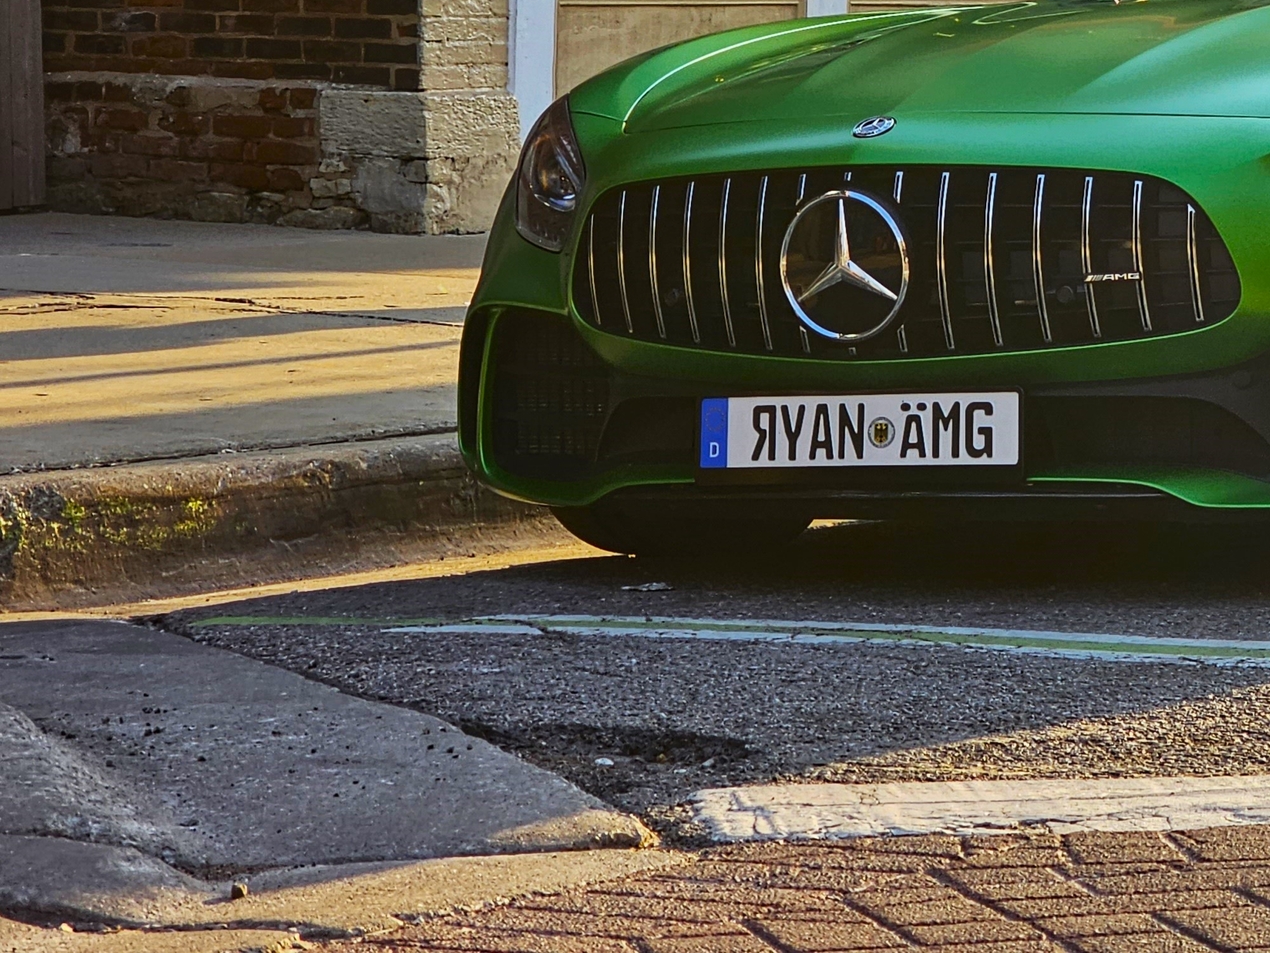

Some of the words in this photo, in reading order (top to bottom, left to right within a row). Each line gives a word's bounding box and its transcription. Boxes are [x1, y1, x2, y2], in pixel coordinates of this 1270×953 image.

[1102, 272, 1140, 282] AMG
[709, 442, 719, 457] D
[900, 401, 993, 459] ÄMG
